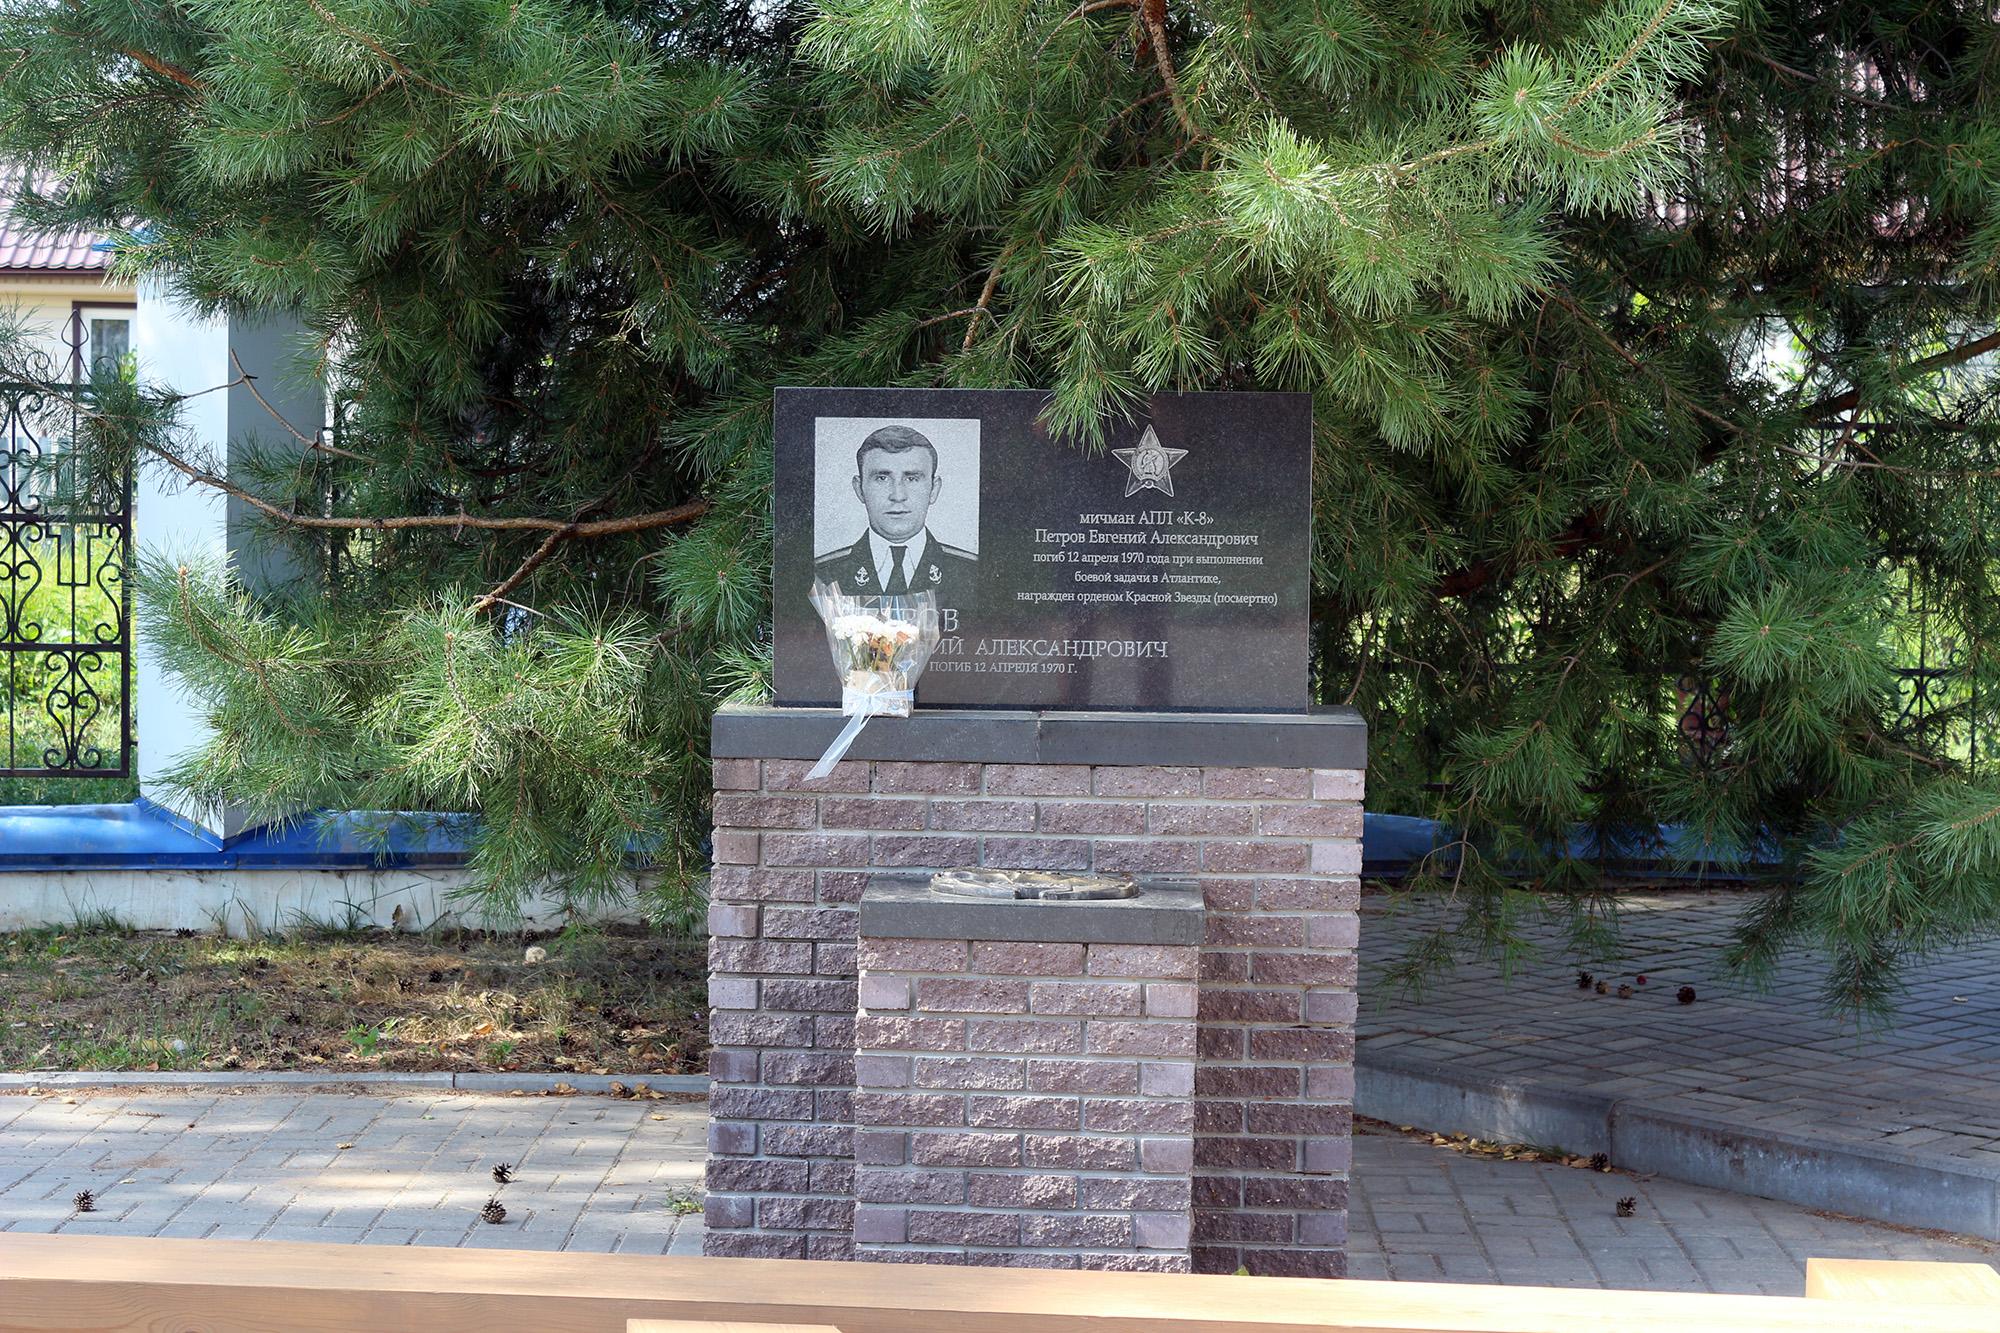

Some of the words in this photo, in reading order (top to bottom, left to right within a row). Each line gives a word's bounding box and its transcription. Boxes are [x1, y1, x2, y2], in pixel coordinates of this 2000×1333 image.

[1080, 513, 1135, 525] мичман
[1138, 510, 1173, 525] АПЛ
[1176, 511, 1214, 526] «К-8»
[1035, 528, 1085, 547] Петров
[1088, 529, 1147, 544] Евгений
[1150, 530, 1259, 549] Александрович
[1033, 551, 1065, 562] погиб
[1067, 552, 1079, 562] 12
[1081, 554, 1119, 566] апреля
[1121, 552, 1144, 563] 1970
[1146, 555, 1170, 565] года
[1172, 555, 1193, 567] при
[1196, 556, 1263, 565] выполнении
[1074, 570, 1112, 583] боевой
[1113, 574, 1150, 584] задачи
[1152, 575, 1159, 583] в
[1161, 572, 1221, 585] Атлантике,
[1017, 592, 1075, 604] награжден
[1077, 592, 1123, 605] орденом
[1125, 591, 1172, 605] Красной
[1174, 591, 1211, 604] Звезды
[1213, 592, 1278, 607] (посмертно)
[975, 639, 1169, 660] АЛЕКСАНДРОВИЧ
[929, 661, 971, 673] ПОГИБ
[974, 663, 986, 673] 12
[989, 662, 1038, 674] АПРЕЛЯ
[1041, 663, 1065, 674] 1970
[1067, 664, 1078, 674] Г.
